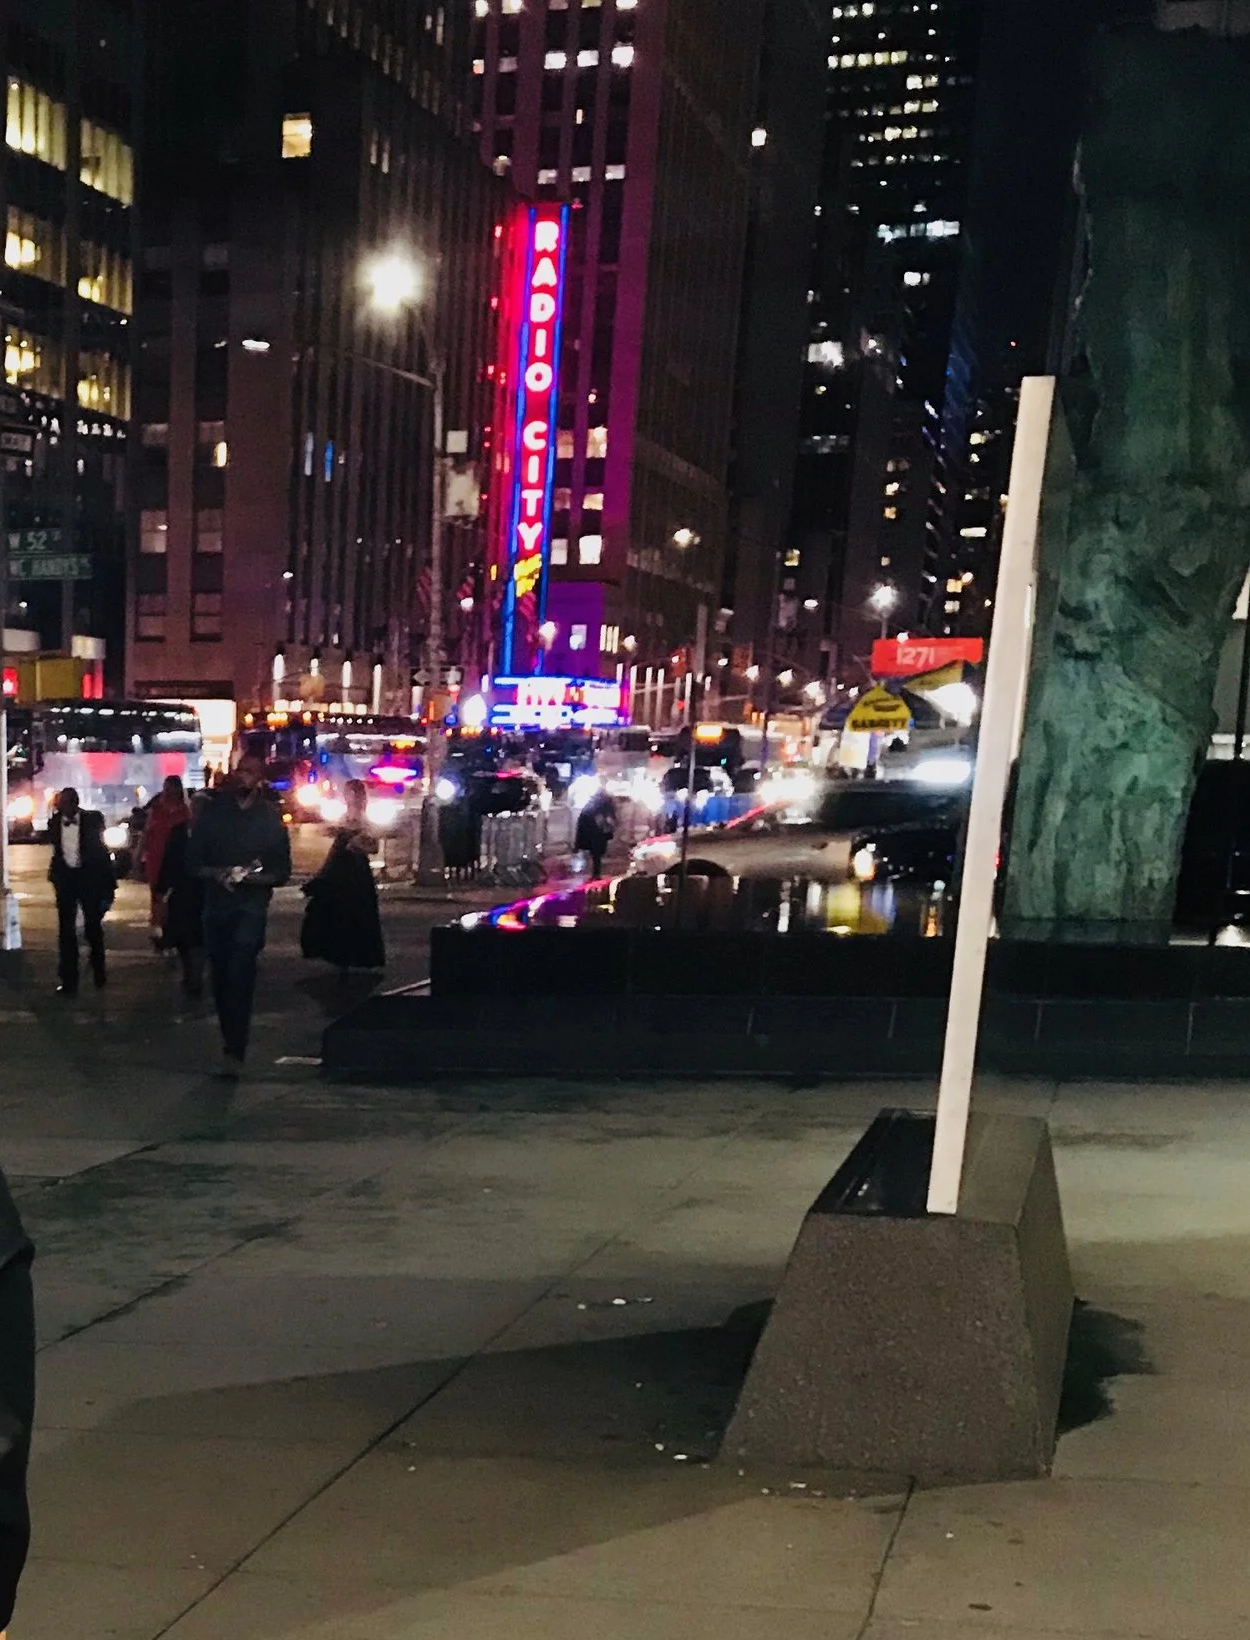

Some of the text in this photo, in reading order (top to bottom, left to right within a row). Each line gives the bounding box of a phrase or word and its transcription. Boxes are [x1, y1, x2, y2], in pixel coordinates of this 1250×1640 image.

[517, 221, 559, 550] RADIO CITY
[27, 531, 47, 549] 52
